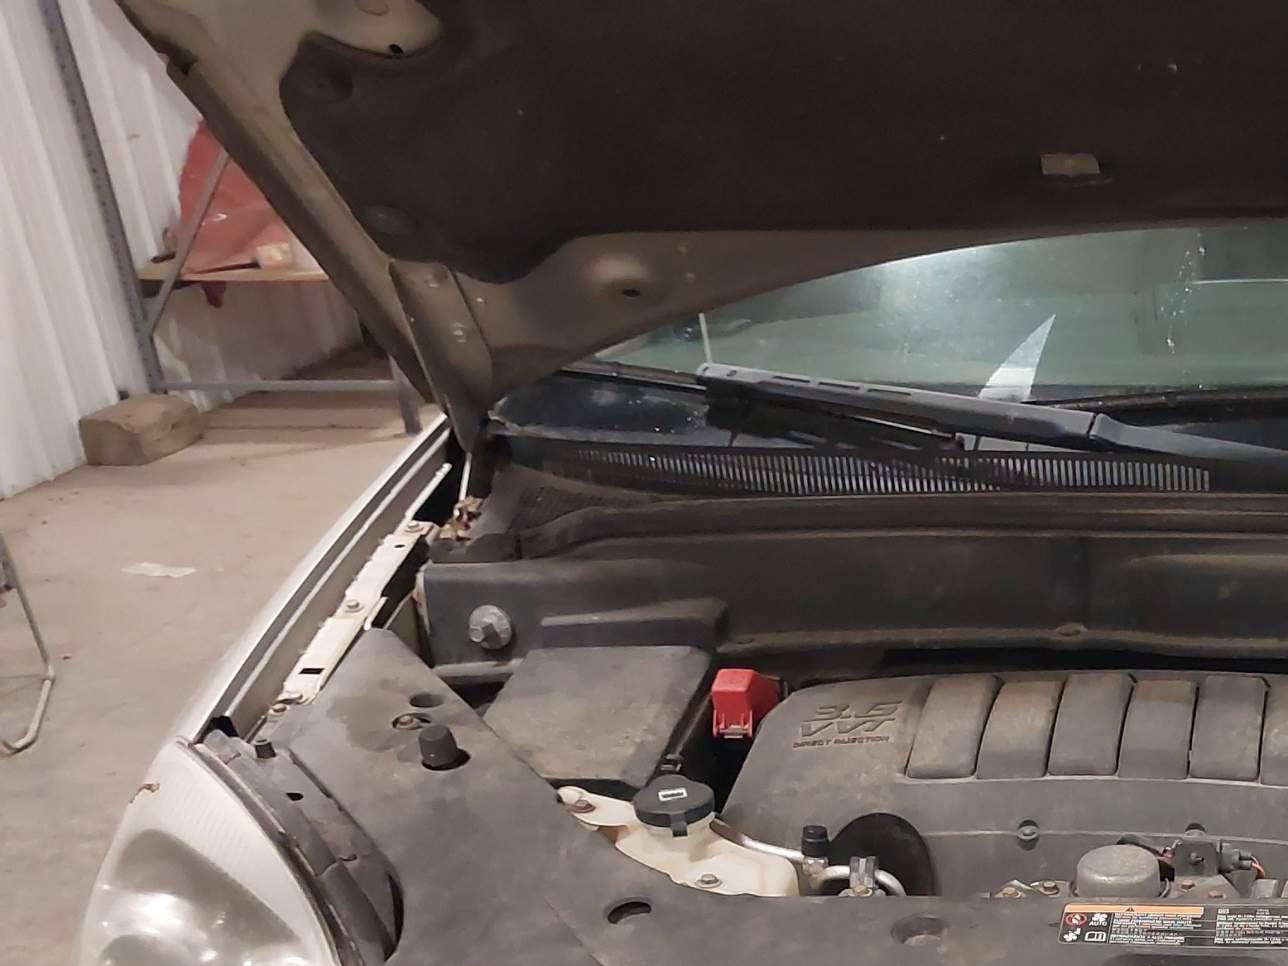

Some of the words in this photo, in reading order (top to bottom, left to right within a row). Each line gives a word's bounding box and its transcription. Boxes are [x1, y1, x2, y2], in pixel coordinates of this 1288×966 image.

[800, 718, 896, 737] VVT
[792, 737, 832, 749] DIRECT
[833, 735, 891, 746] INJECTION
